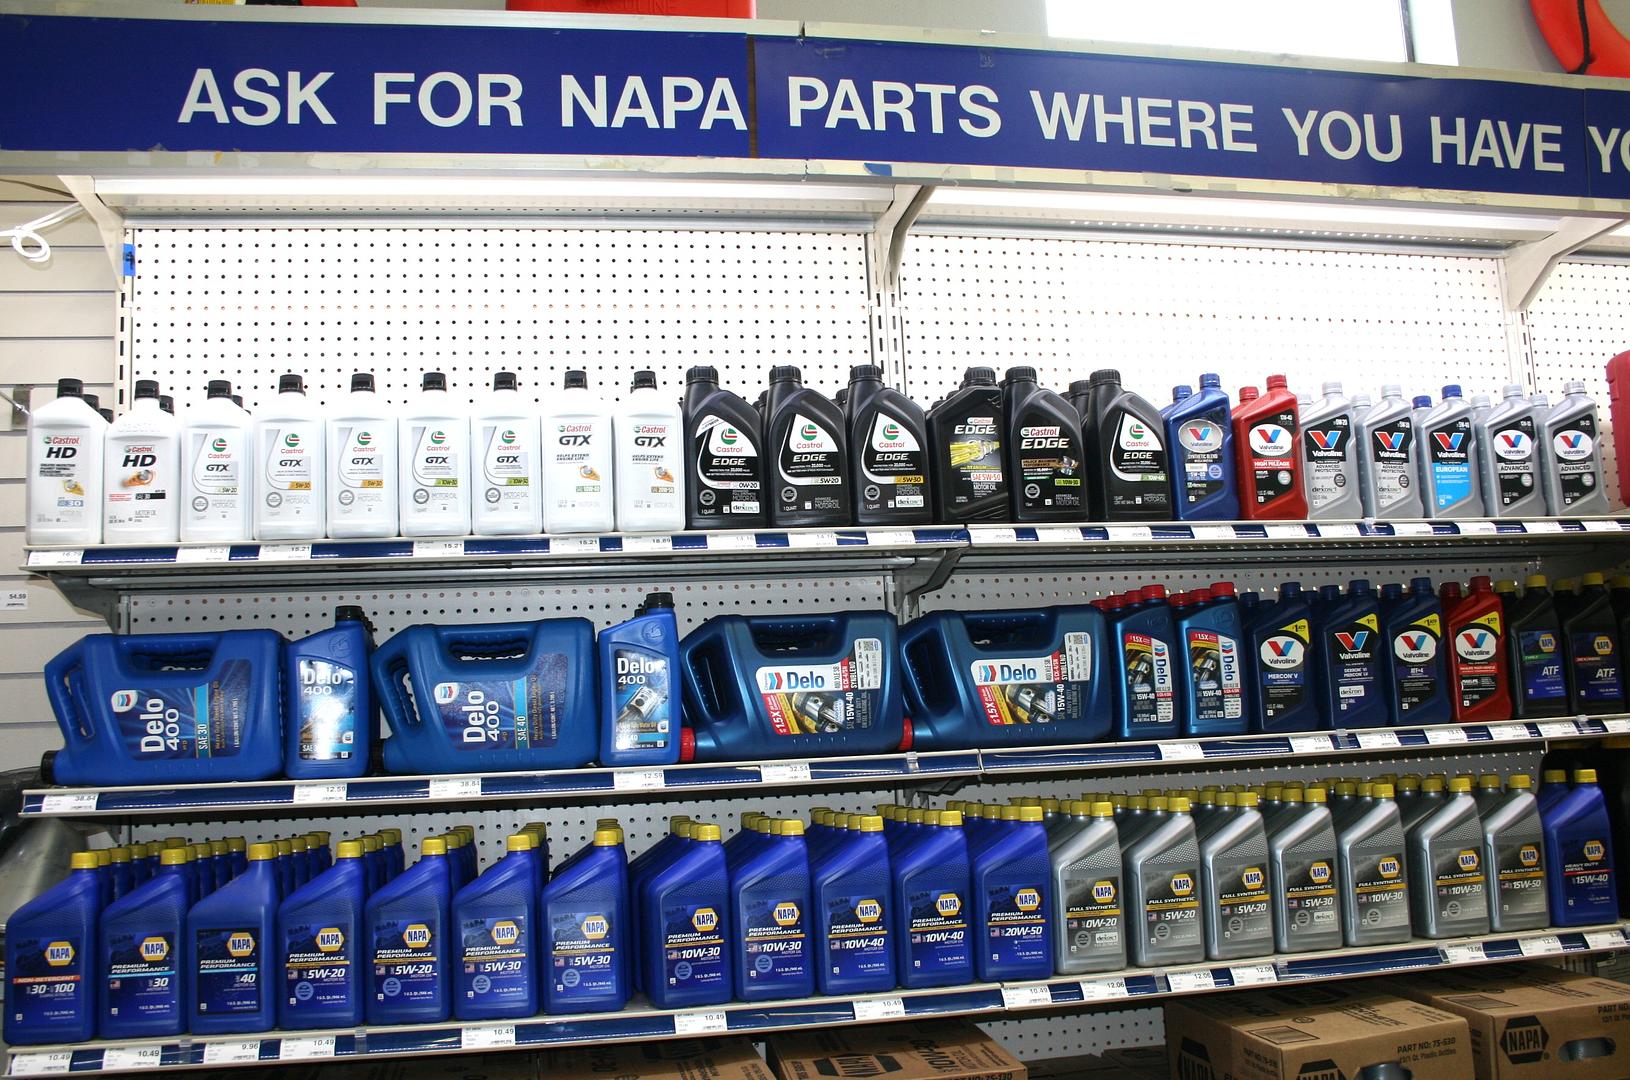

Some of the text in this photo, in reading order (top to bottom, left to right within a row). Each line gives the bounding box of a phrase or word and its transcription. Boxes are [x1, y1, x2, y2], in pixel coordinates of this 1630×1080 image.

[178, 68, 338, 126] ASK
[374, 72, 524, 129] FOR
[561, 75, 748, 131] NAPA
[788, 76, 1002, 138] PARTS
[1028, 90, 1258, 153] WHERE
[1282, 106, 1402, 163] YOU
[1431, 115, 1565, 173] HAVE
[566, 424, 592, 433] Castrol
[641, 425, 666, 434] Castrol
[954, 425, 998, 434] EDGE
[1030, 428, 1057, 437] Castrol
[559, 435, 592, 447] GTX
[634, 436, 667, 448] GTX
[796, 442, 823, 450] Castrol
[878, 441, 905, 449] Castrol
[1020, 438, 1071, 449] EDGE
[46, 447, 77, 459] HD
[716, 445, 743, 453] Castrol
[1311, 450, 1344, 458] Valvoline
[122, 454, 157, 467] HD
[279, 459, 302, 467] GTX
[351, 457, 374, 465] GTX
[426, 456, 448, 464] GTX
[497, 456, 520, 464] GTX
[711, 458, 746, 466] EDGE
[792, 453, 827, 462] EDGE
[875, 453, 909, 462] EDGE
[206, 463, 229, 472] GTX
[819, 477, 840, 485] 5W-20
[1339, 652, 1371, 660] Valvoline
[617, 657, 655, 674] Delo
[1222, 656, 1233, 681] Delo
[1542, 665, 1560, 676] ATF
[304, 668, 344, 686] Delo
[849, 661, 858, 689] SYNBLEND
[1000, 664, 1037, 682] Delo
[1155, 658, 1166, 685] Delo
[1595, 668, 1616, 678] ATF
[618, 675, 645, 685] 400
[787, 671, 826, 689] Delo
[304, 687, 333, 695] 400
[1136, 692, 1155, 700] 15W-40
[1202, 689, 1222, 697] 15W-40
[1056, 683, 1065, 712] 15W-40
[846, 691, 855, 721] 15W-40
[461, 690, 487, 743] Delo
[486, 701, 500, 742] 400
[140, 698, 165, 753] Delo
[165, 708, 181, 752] 400
[517, 715, 527, 741] SAE 40
[198, 723, 209, 750] SAE 30
[1522, 851, 1537, 861] NAPA
[1587, 846, 1602, 855] NAPA
[1461, 856, 1477, 865] NAPA
[1312, 867, 1328, 878] NAPA
[1382, 862, 1398, 873] NAPA
[1245, 872, 1261, 884] NAPA
[1575, 874, 1608, 885] 15W-40
[1174, 880, 1190, 890] NAPA
[1451, 884, 1482, 895] 10W-30
[1512, 880, 1542, 890] 15W-50
[1096, 887, 1112, 898] NAPA
[1371, 892, 1404, 903] 10W-30
[939, 899, 958, 911] NAPA
[1019, 894, 1037, 905] NAPA
[1305, 897, 1334, 908] 5W-30
[777, 908, 796, 919] NAPA
[860, 905, 878, 916] NAPA
[1238, 903, 1267, 915] 5W-20
[696, 914, 715, 925] NAPA
[1165, 910, 1196, 921] 5W-20
[586, 922, 605, 933] NAPA
[1085, 918, 1118, 929] 0W-20
[408, 930, 427, 941] NAPA
[496, 927, 515, 939] NAPA
[831, 926, 884, 934] PERFORMANCE
[1005, 926, 1043, 937] 20W-50
[320, 934, 340, 945] NAPA
[925, 931, 964, 943] 10W-40
[144, 943, 165, 955] NAPA
[231, 939, 251, 950] NAPA
[762, 941, 802, 953] 10W-30
[845, 938, 885, 949] 10W-40
[49, 948, 71, 960] NAPA
[681, 947, 721, 959] 10W-30
[574, 955, 611, 966] 5W-30
[395, 965, 433, 976] 5W-20
[485, 961, 522, 973] 5W-30
[18, 975, 75, 984] NON-DETERGENT
[240, 974, 256, 984] 40
[308, 968, 346, 980] 5W-20
[154, 978, 169, 987] 30
[1508, 1028, 1540, 1052] NAPA
[1397, 1045, 1417, 1054] PART
[1418, 1043, 1431, 1051] NO:
[49, 1054, 71, 1062] 10.49
